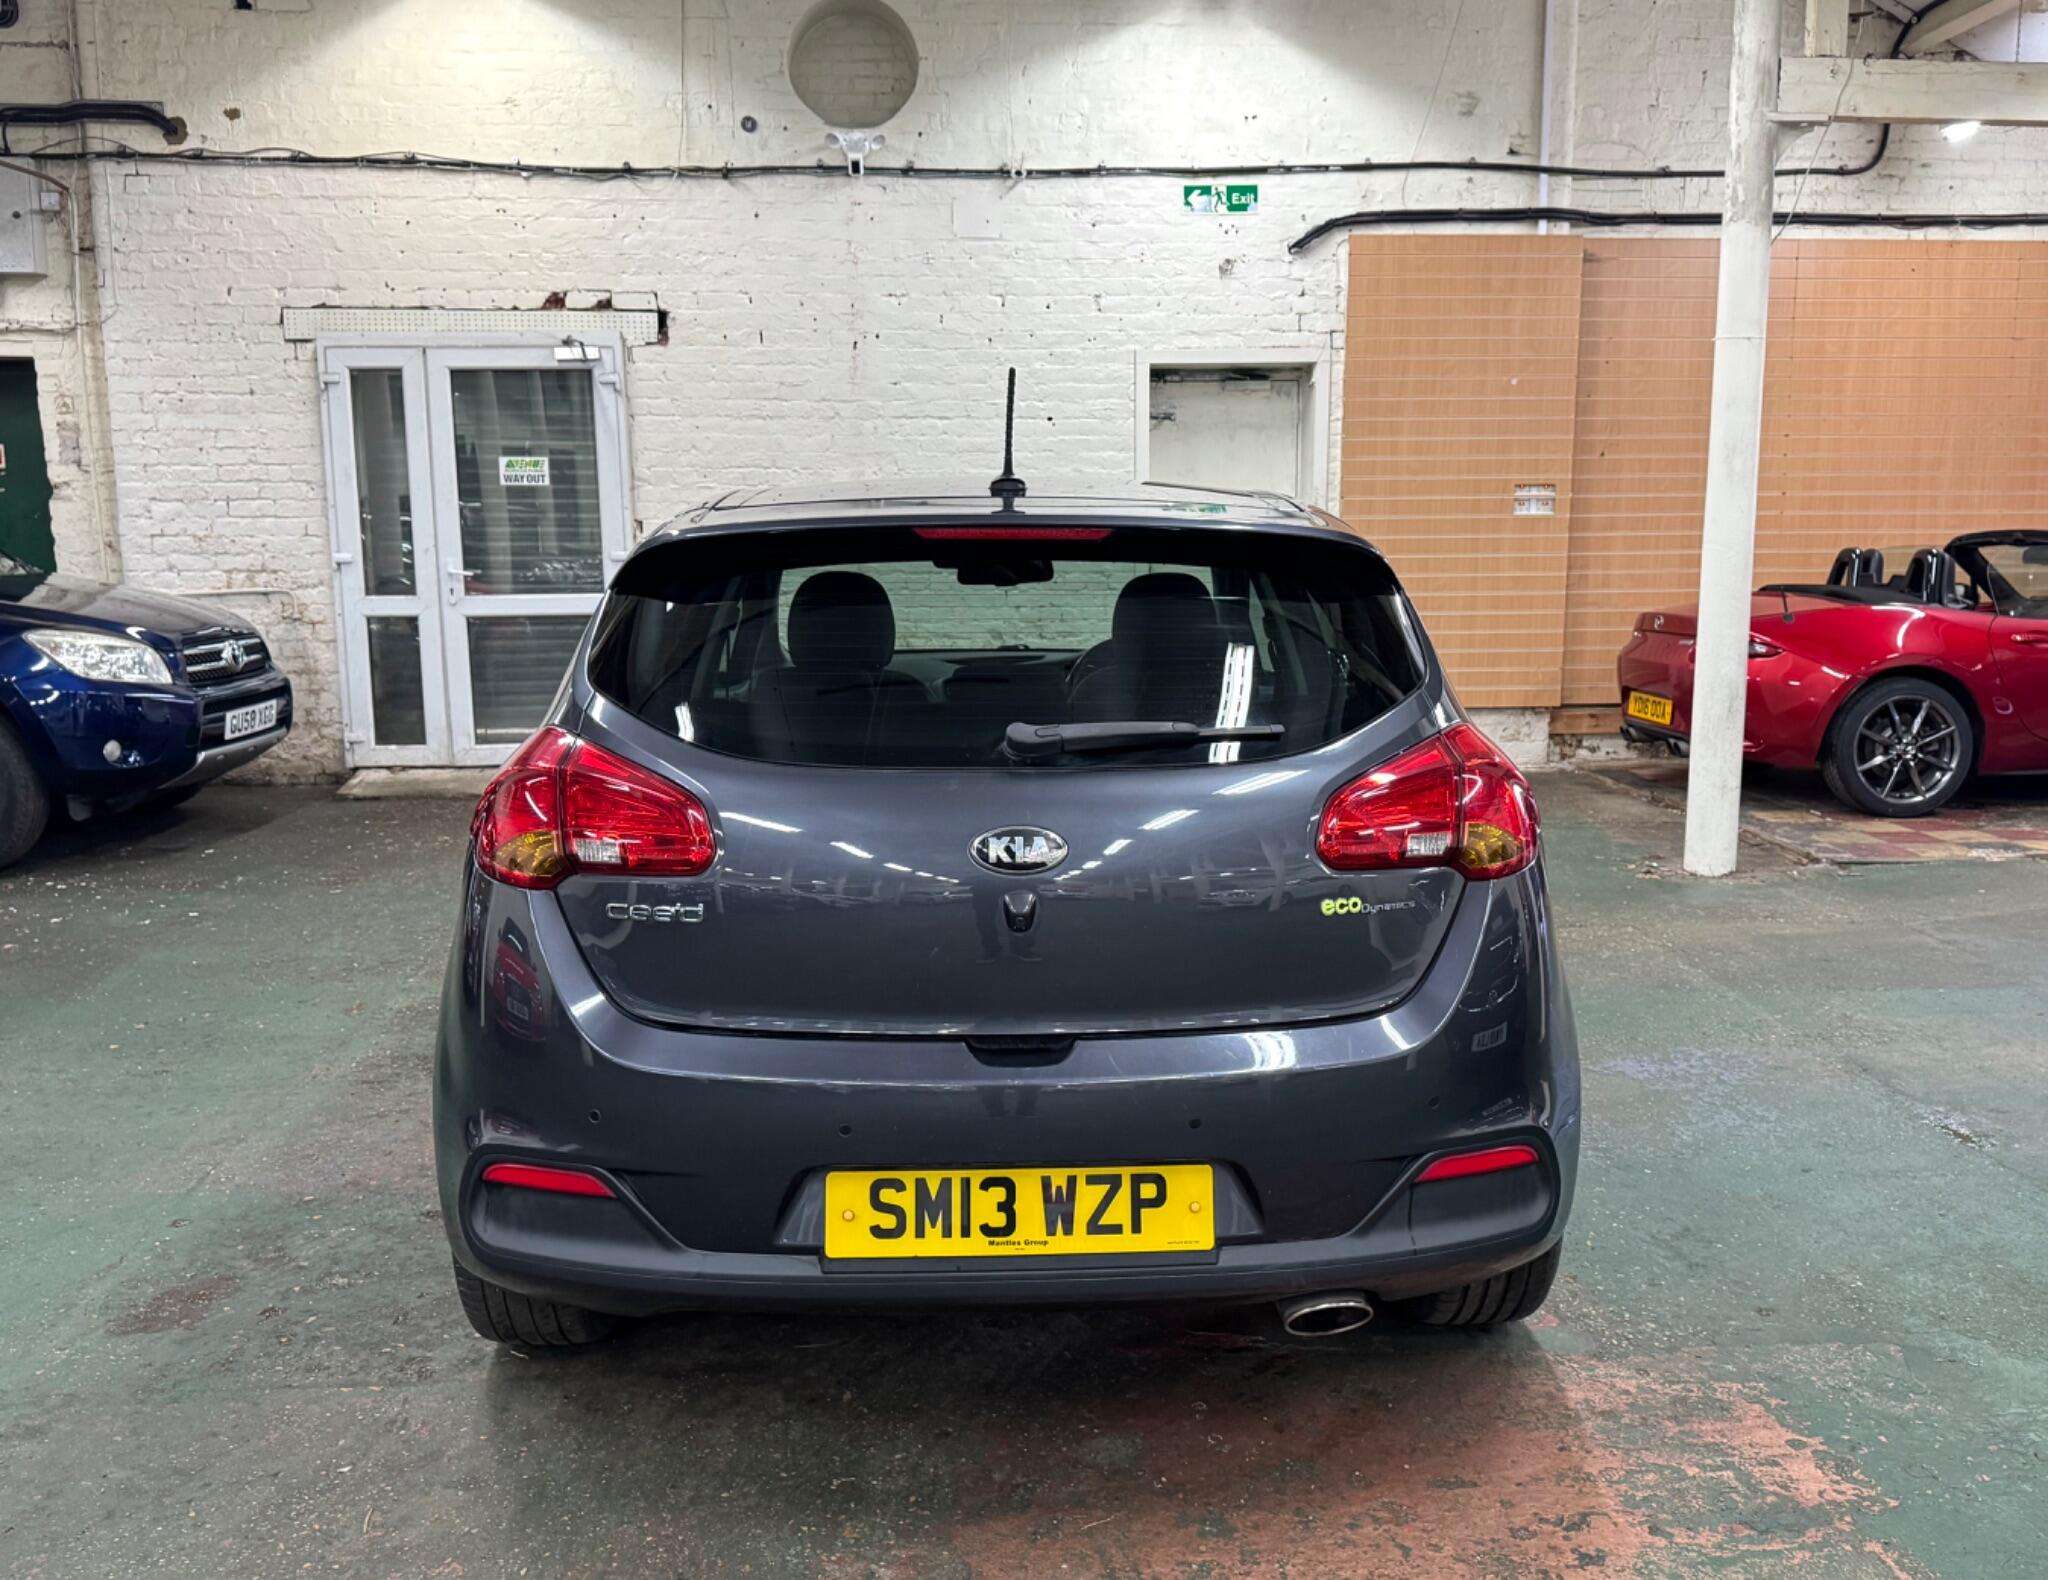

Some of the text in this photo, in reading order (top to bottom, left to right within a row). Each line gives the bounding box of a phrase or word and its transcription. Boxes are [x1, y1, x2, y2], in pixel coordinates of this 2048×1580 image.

[1231, 192, 1255, 205] Exit
[503, 474, 546, 484] WAY OUT
[230, 709, 257, 734] GU58
[987, 836, 1051, 864] KIA
[868, 1172, 1168, 1240] SM13 WZP
[1023, 1238, 1049, 1248] Group
